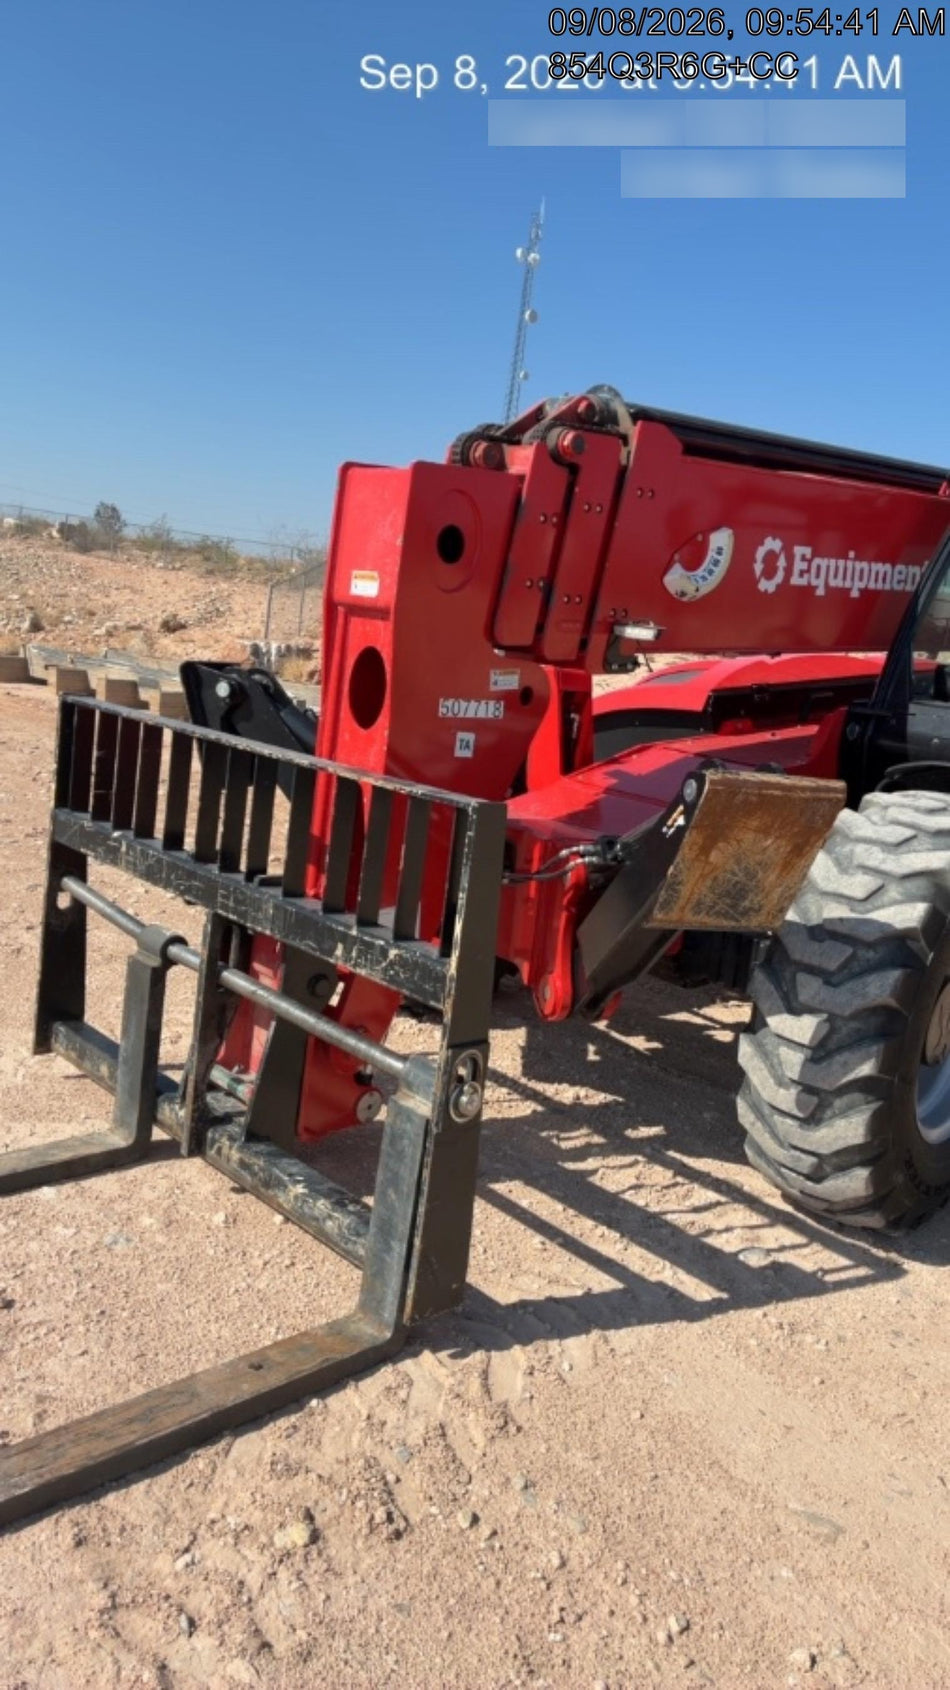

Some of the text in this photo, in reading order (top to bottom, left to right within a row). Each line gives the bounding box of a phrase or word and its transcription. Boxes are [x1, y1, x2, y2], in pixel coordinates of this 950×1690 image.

[790, 545, 929, 598] Equipmen
[440, 699, 502, 719] 507718
[459, 738, 471, 752] TA
